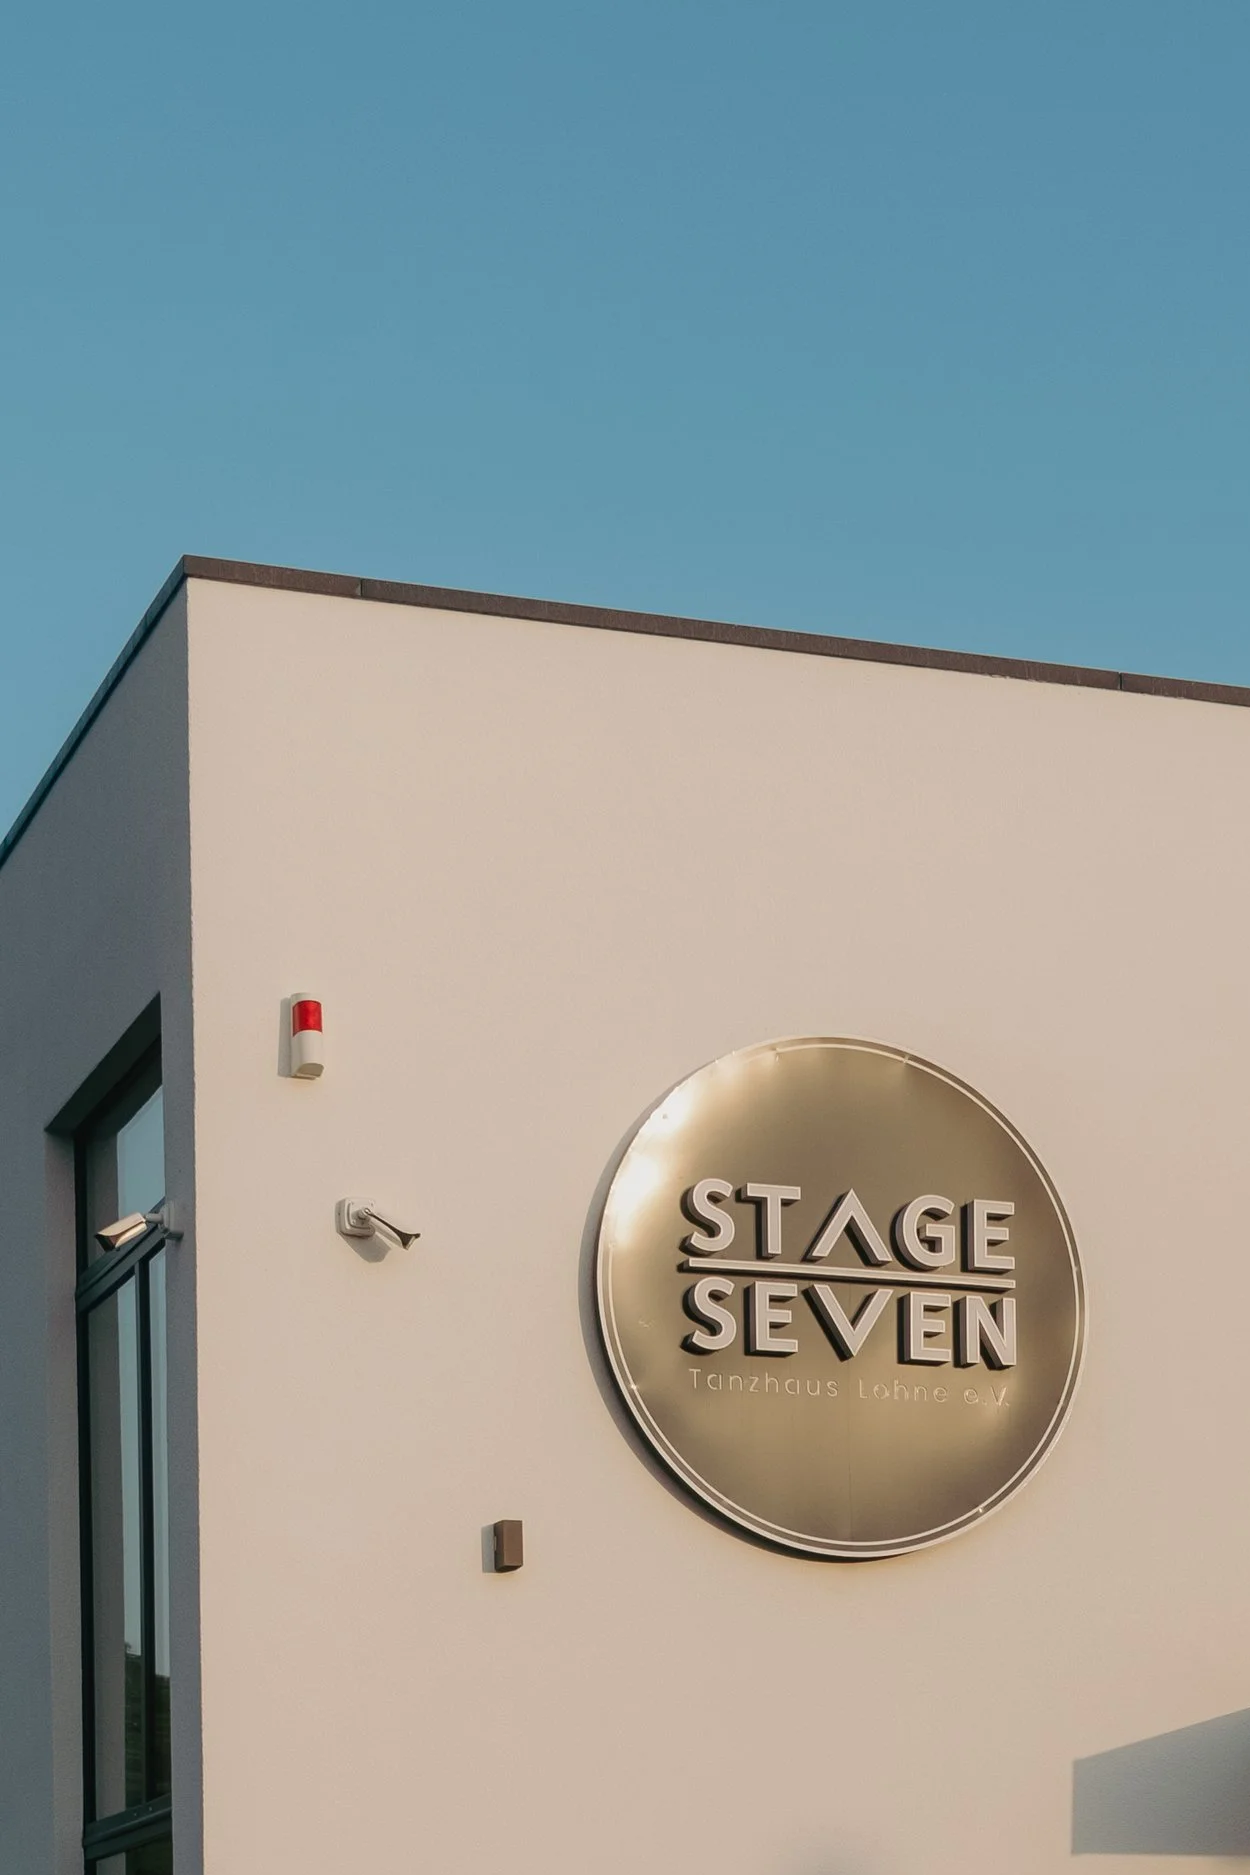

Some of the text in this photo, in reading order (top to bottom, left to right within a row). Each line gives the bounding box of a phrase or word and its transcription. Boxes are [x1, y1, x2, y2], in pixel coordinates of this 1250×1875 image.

[682, 1178, 1015, 1271] STAGE
[682, 1277, 1016, 1369] SEVEN
[688, 1368, 839, 1397] Tanzhaus
[859, 1379, 949, 1403] Lohne
